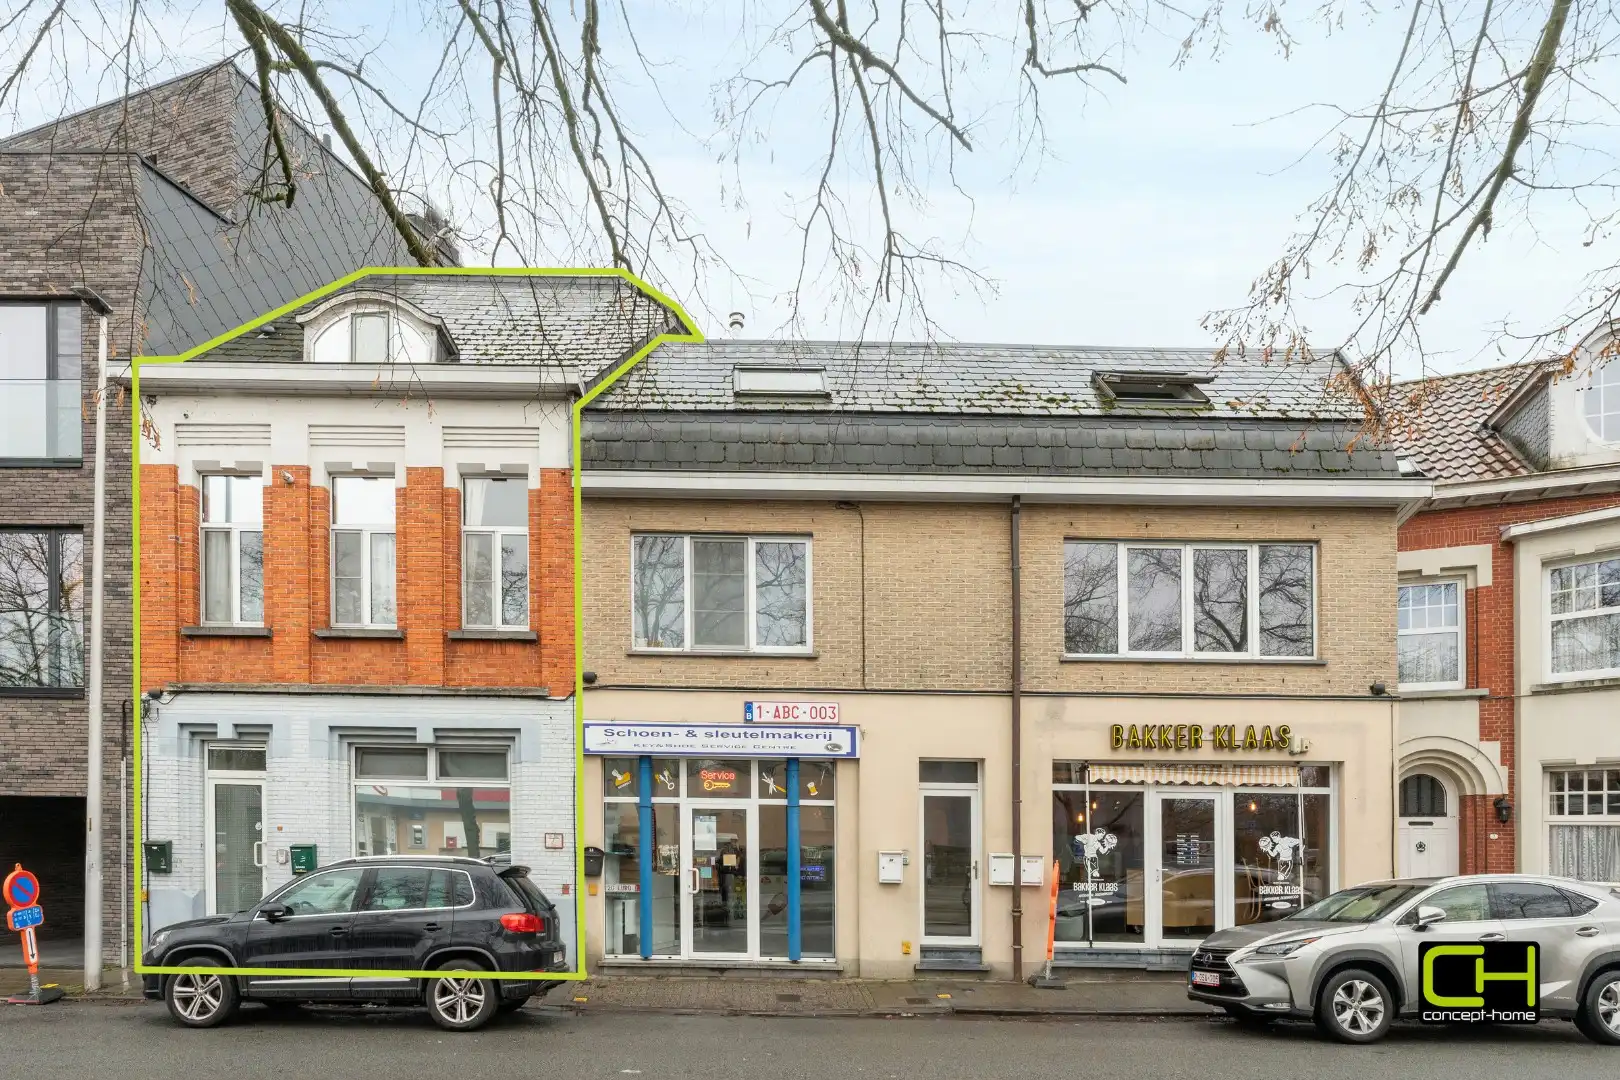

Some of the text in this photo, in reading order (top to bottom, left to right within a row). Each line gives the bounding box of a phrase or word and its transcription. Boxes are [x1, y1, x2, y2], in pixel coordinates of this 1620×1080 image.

[756, 704, 837, 720] 1-ABC-003
[603, 728, 833, 742] Schoen- & sleutelmakerij
[1111, 724, 1291, 749] BAKKER KLAAS
[701, 770, 735, 781] Service
